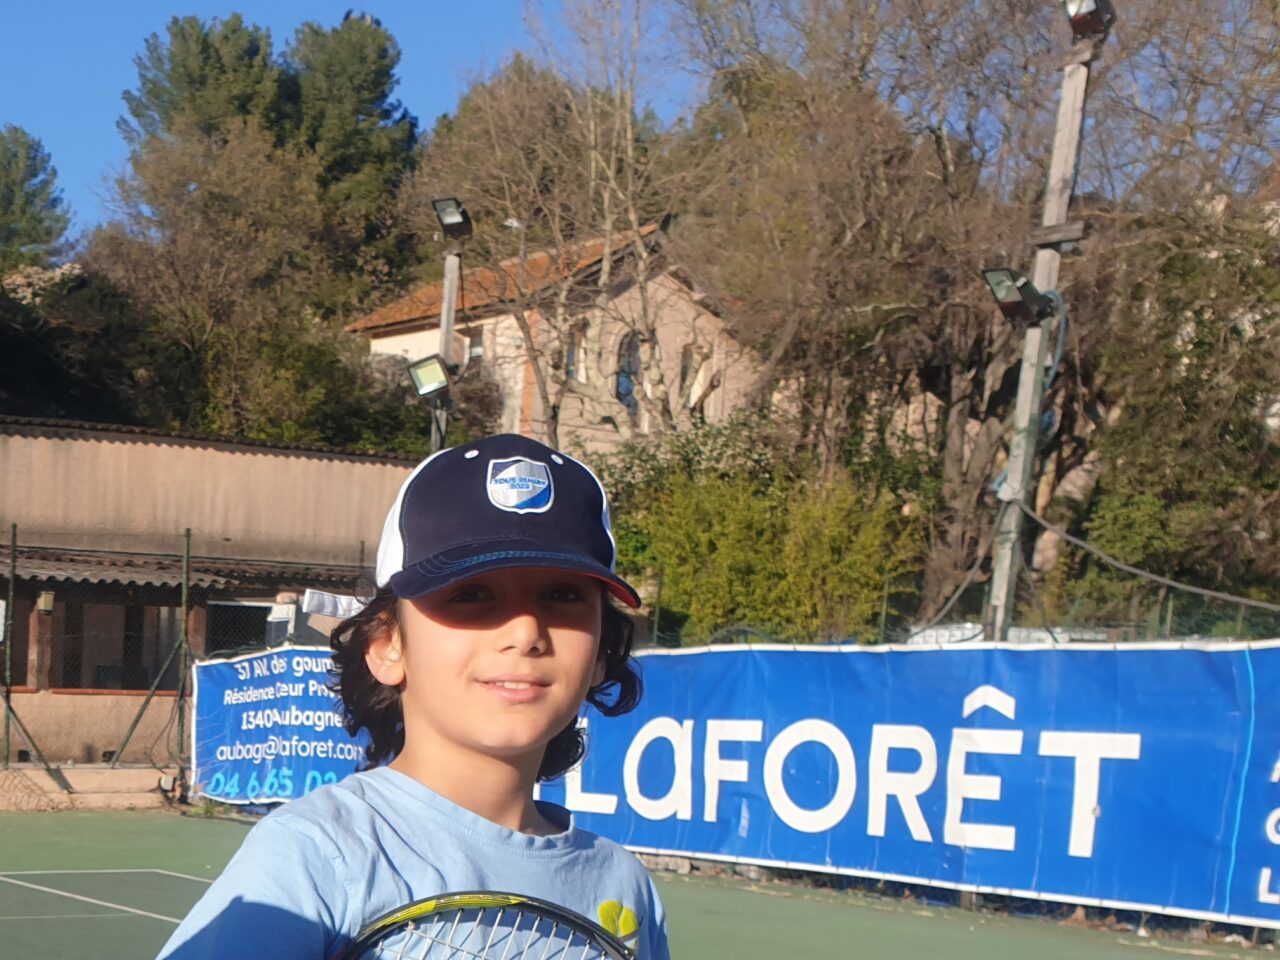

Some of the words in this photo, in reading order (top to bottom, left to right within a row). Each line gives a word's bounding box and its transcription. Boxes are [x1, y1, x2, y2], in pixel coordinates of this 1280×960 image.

[233, 661, 251, 681] 37
[223, 687, 275, 705] Résidence
[207, 771, 240, 800] 04
